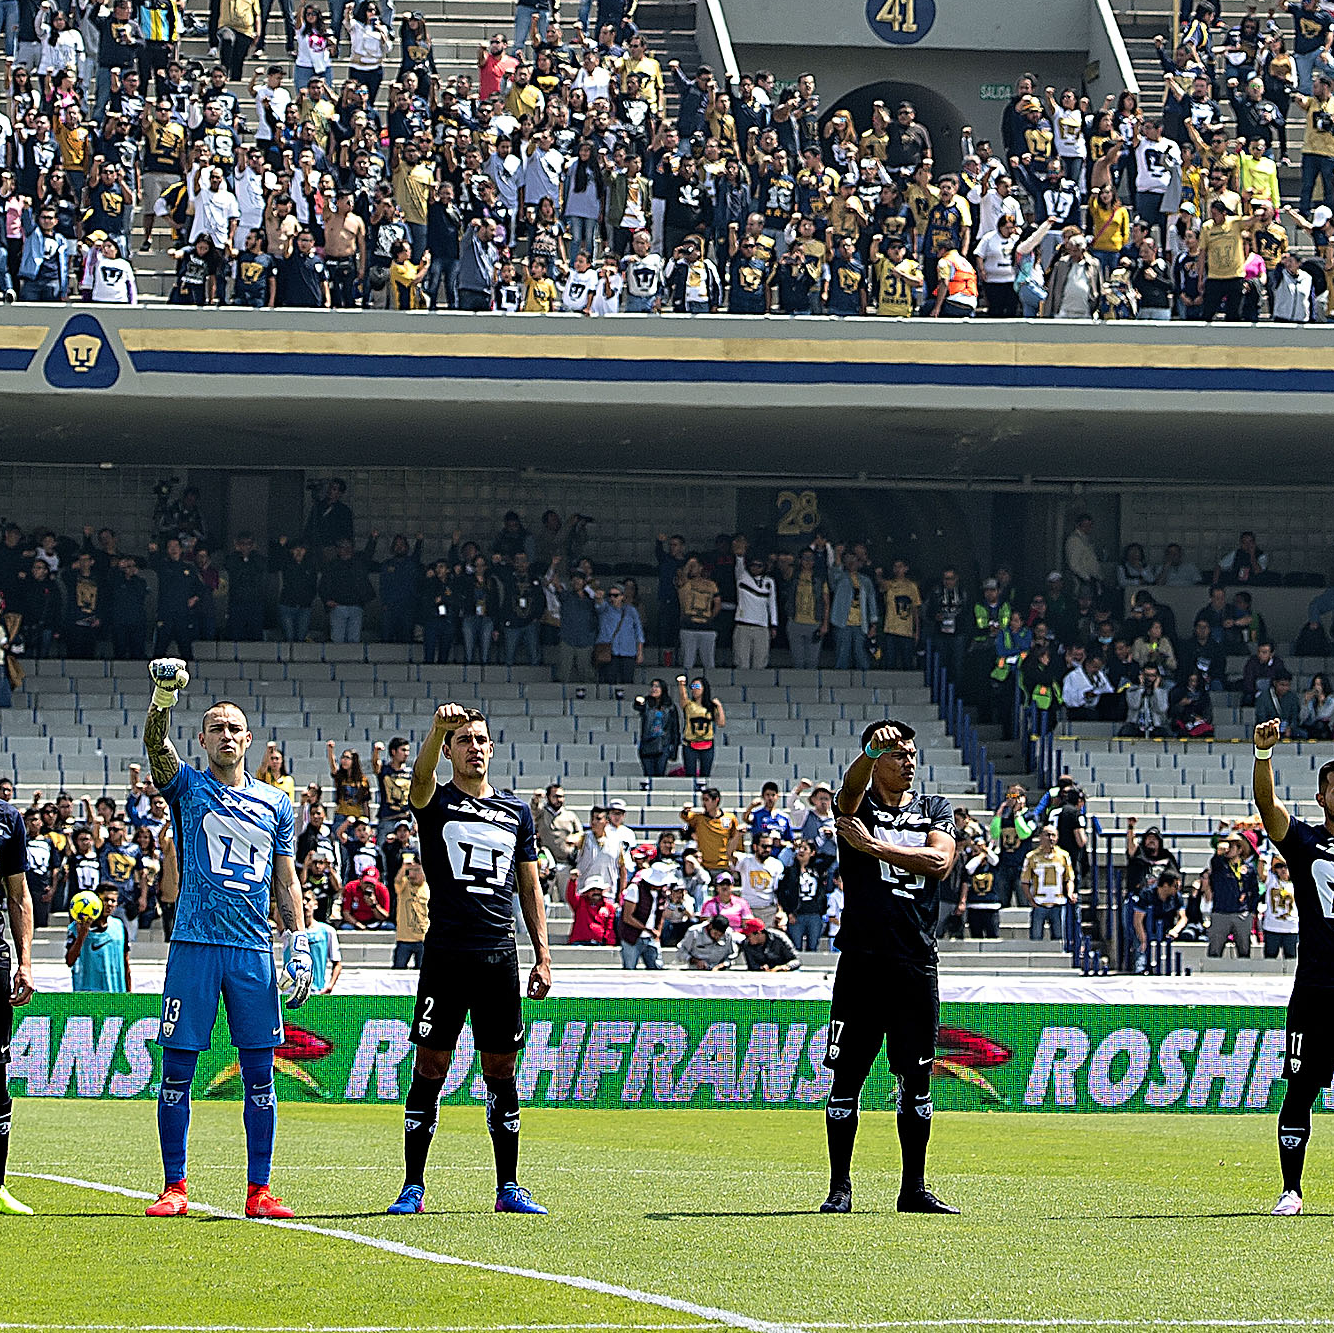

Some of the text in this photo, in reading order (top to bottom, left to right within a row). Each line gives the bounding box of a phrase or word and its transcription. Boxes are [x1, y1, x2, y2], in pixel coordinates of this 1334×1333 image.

[883, 274, 907, 298] 31
[776, 491, 820, 535] 28
[164, 997, 182, 1022] 13
[422, 997, 435, 1020] 2
[831, 1020, 845, 1043] 17
[1291, 1032, 1304, 1056] 11
